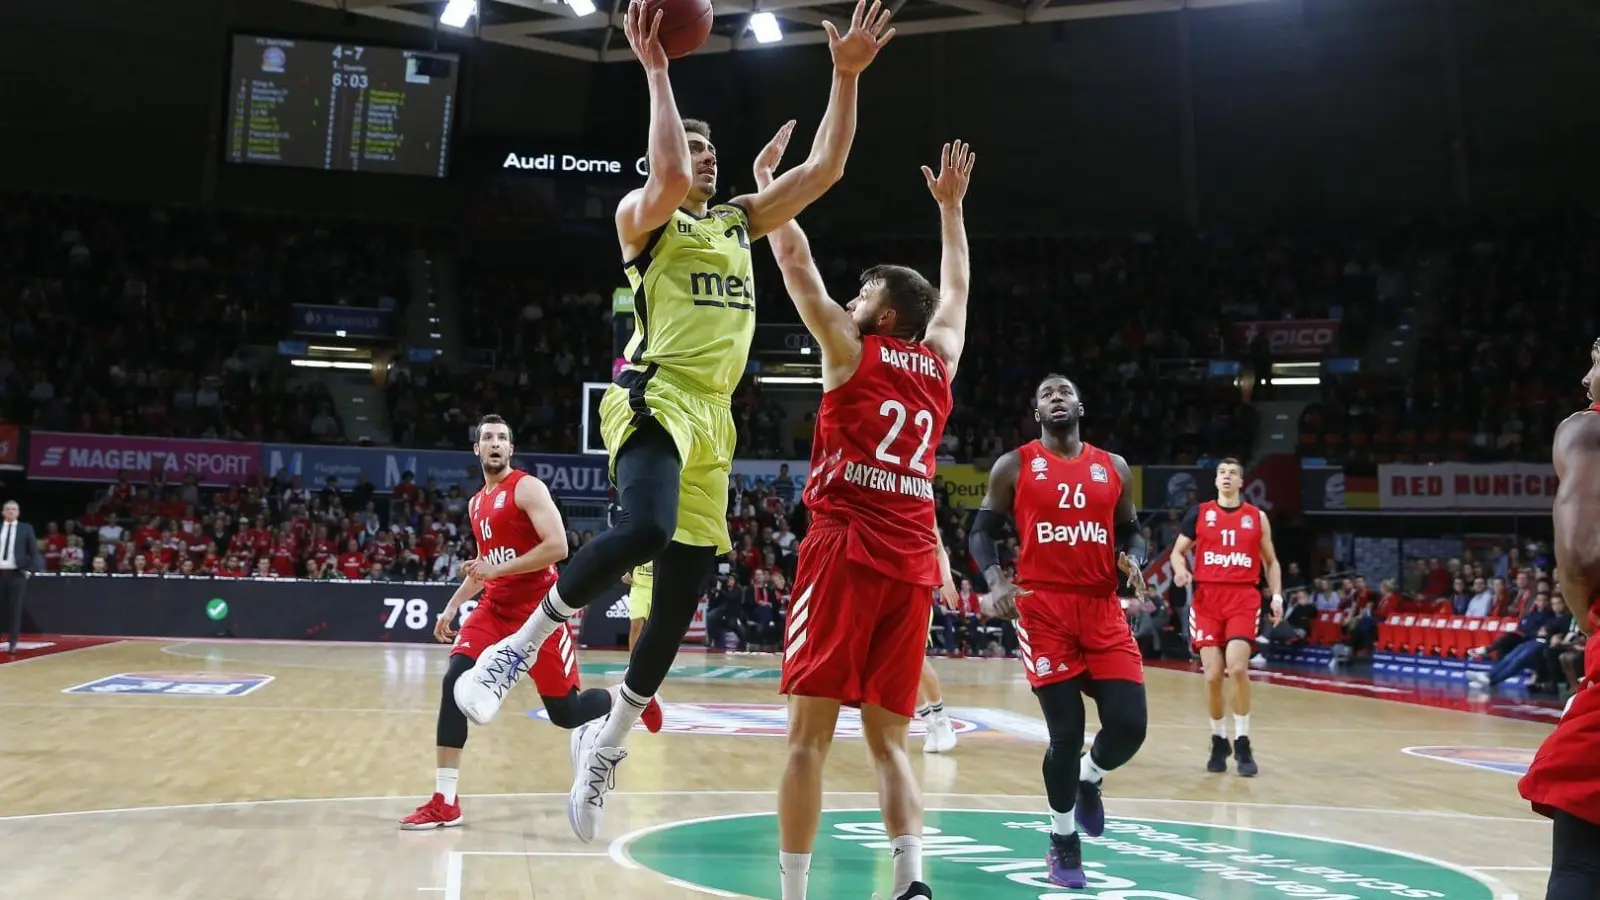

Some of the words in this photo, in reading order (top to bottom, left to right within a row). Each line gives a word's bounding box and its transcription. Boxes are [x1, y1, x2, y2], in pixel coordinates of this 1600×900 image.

[331, 44, 365, 61] 4-7
[331, 72, 369, 89] 6:03
[503, 153, 555, 170] Audi
[561, 155, 622, 173] Dome
[875, 400, 933, 474] 22
[184, 453, 251, 475] SPORT
[844, 461, 896, 493] BAYERN
[1391, 475, 1443, 497] RED
[1057, 482, 1086, 509] 26
[480, 517, 492, 541] 16
[1036, 520, 1107, 546] BayWa
[1220, 529, 1236, 546] 11
[1203, 551, 1252, 568] BayWa
[384, 598, 428, 629] 78
[831, 822, 1204, 900] ayWa
